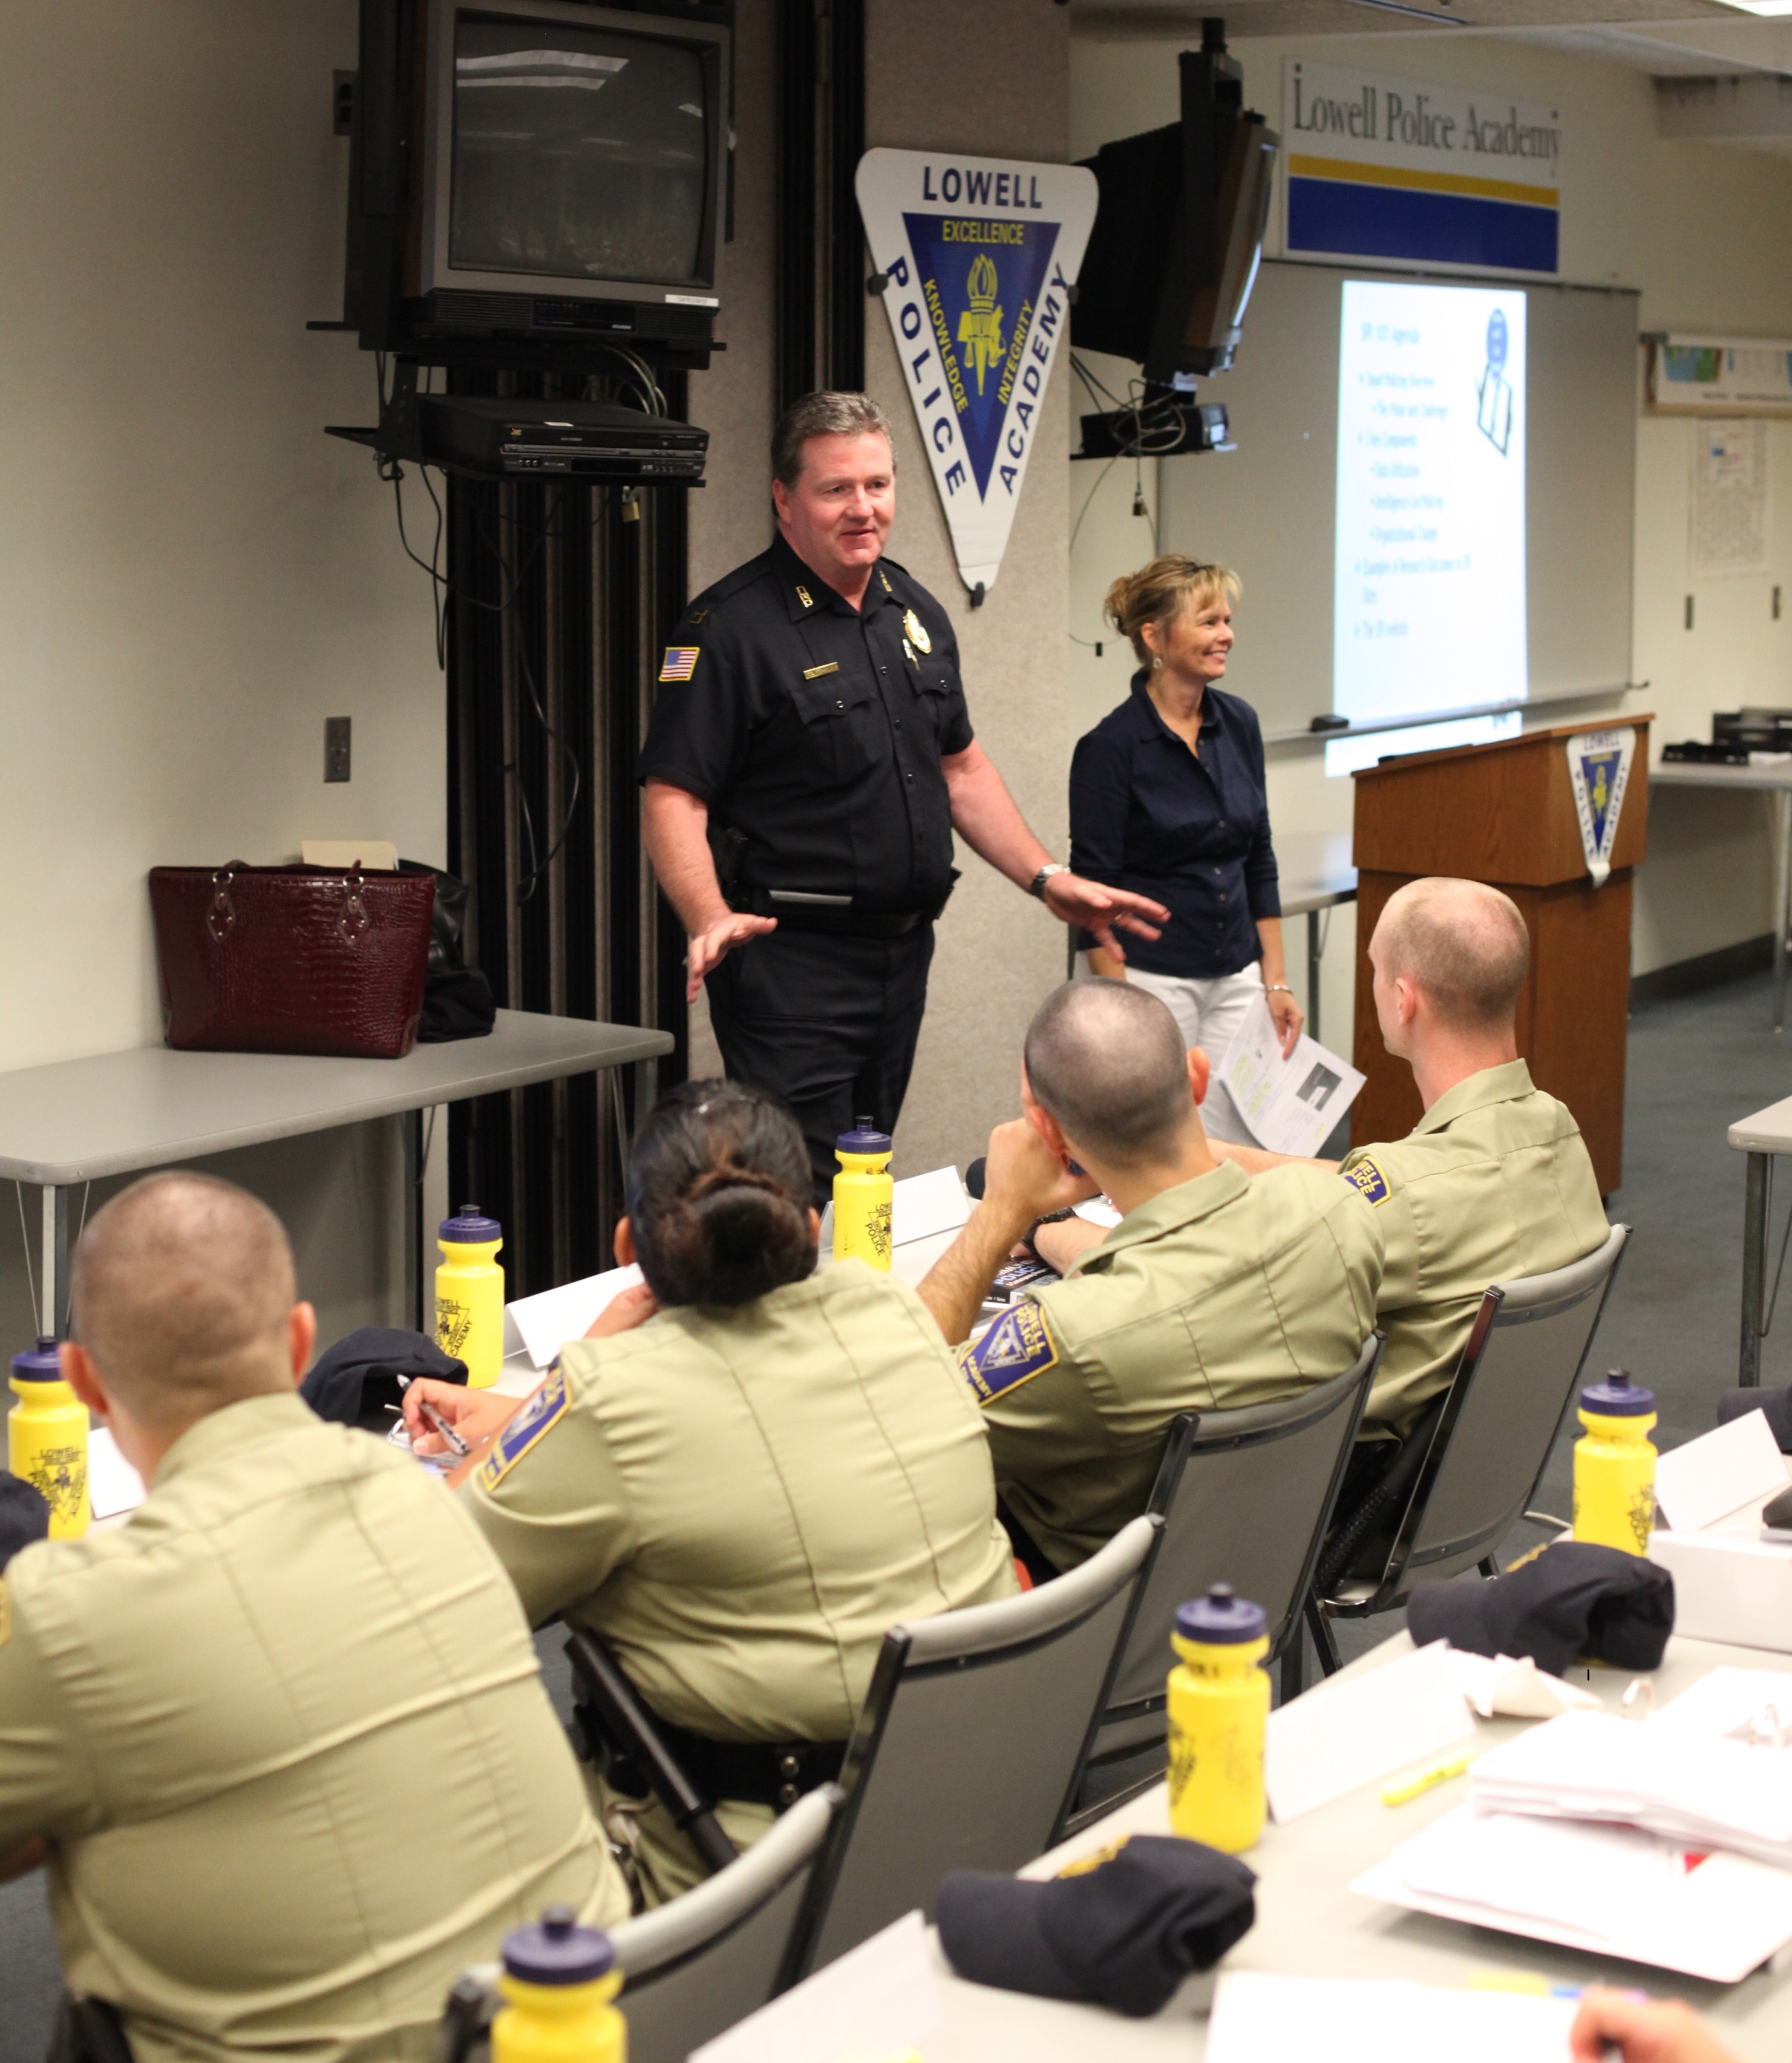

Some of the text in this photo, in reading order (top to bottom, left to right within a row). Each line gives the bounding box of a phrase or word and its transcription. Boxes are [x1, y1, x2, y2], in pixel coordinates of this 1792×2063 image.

[1294, 78, 1561, 177] Lowell Police Academy
[923, 166, 1042, 209] LOWELL
[943, 220, 1025, 244] EXCELLENCE
[886, 255, 966, 496] POLICE
[924, 278, 968, 414] KNOWLEDGE
[998, 299, 1033, 405] INTEGRITY
[999, 261, 1074, 495] ACADEMY
[1584, 730, 1619, 750] LOWELL
[865, 1223, 885, 1256] POLICE
[451, 1320, 472, 1357] CADEMY
